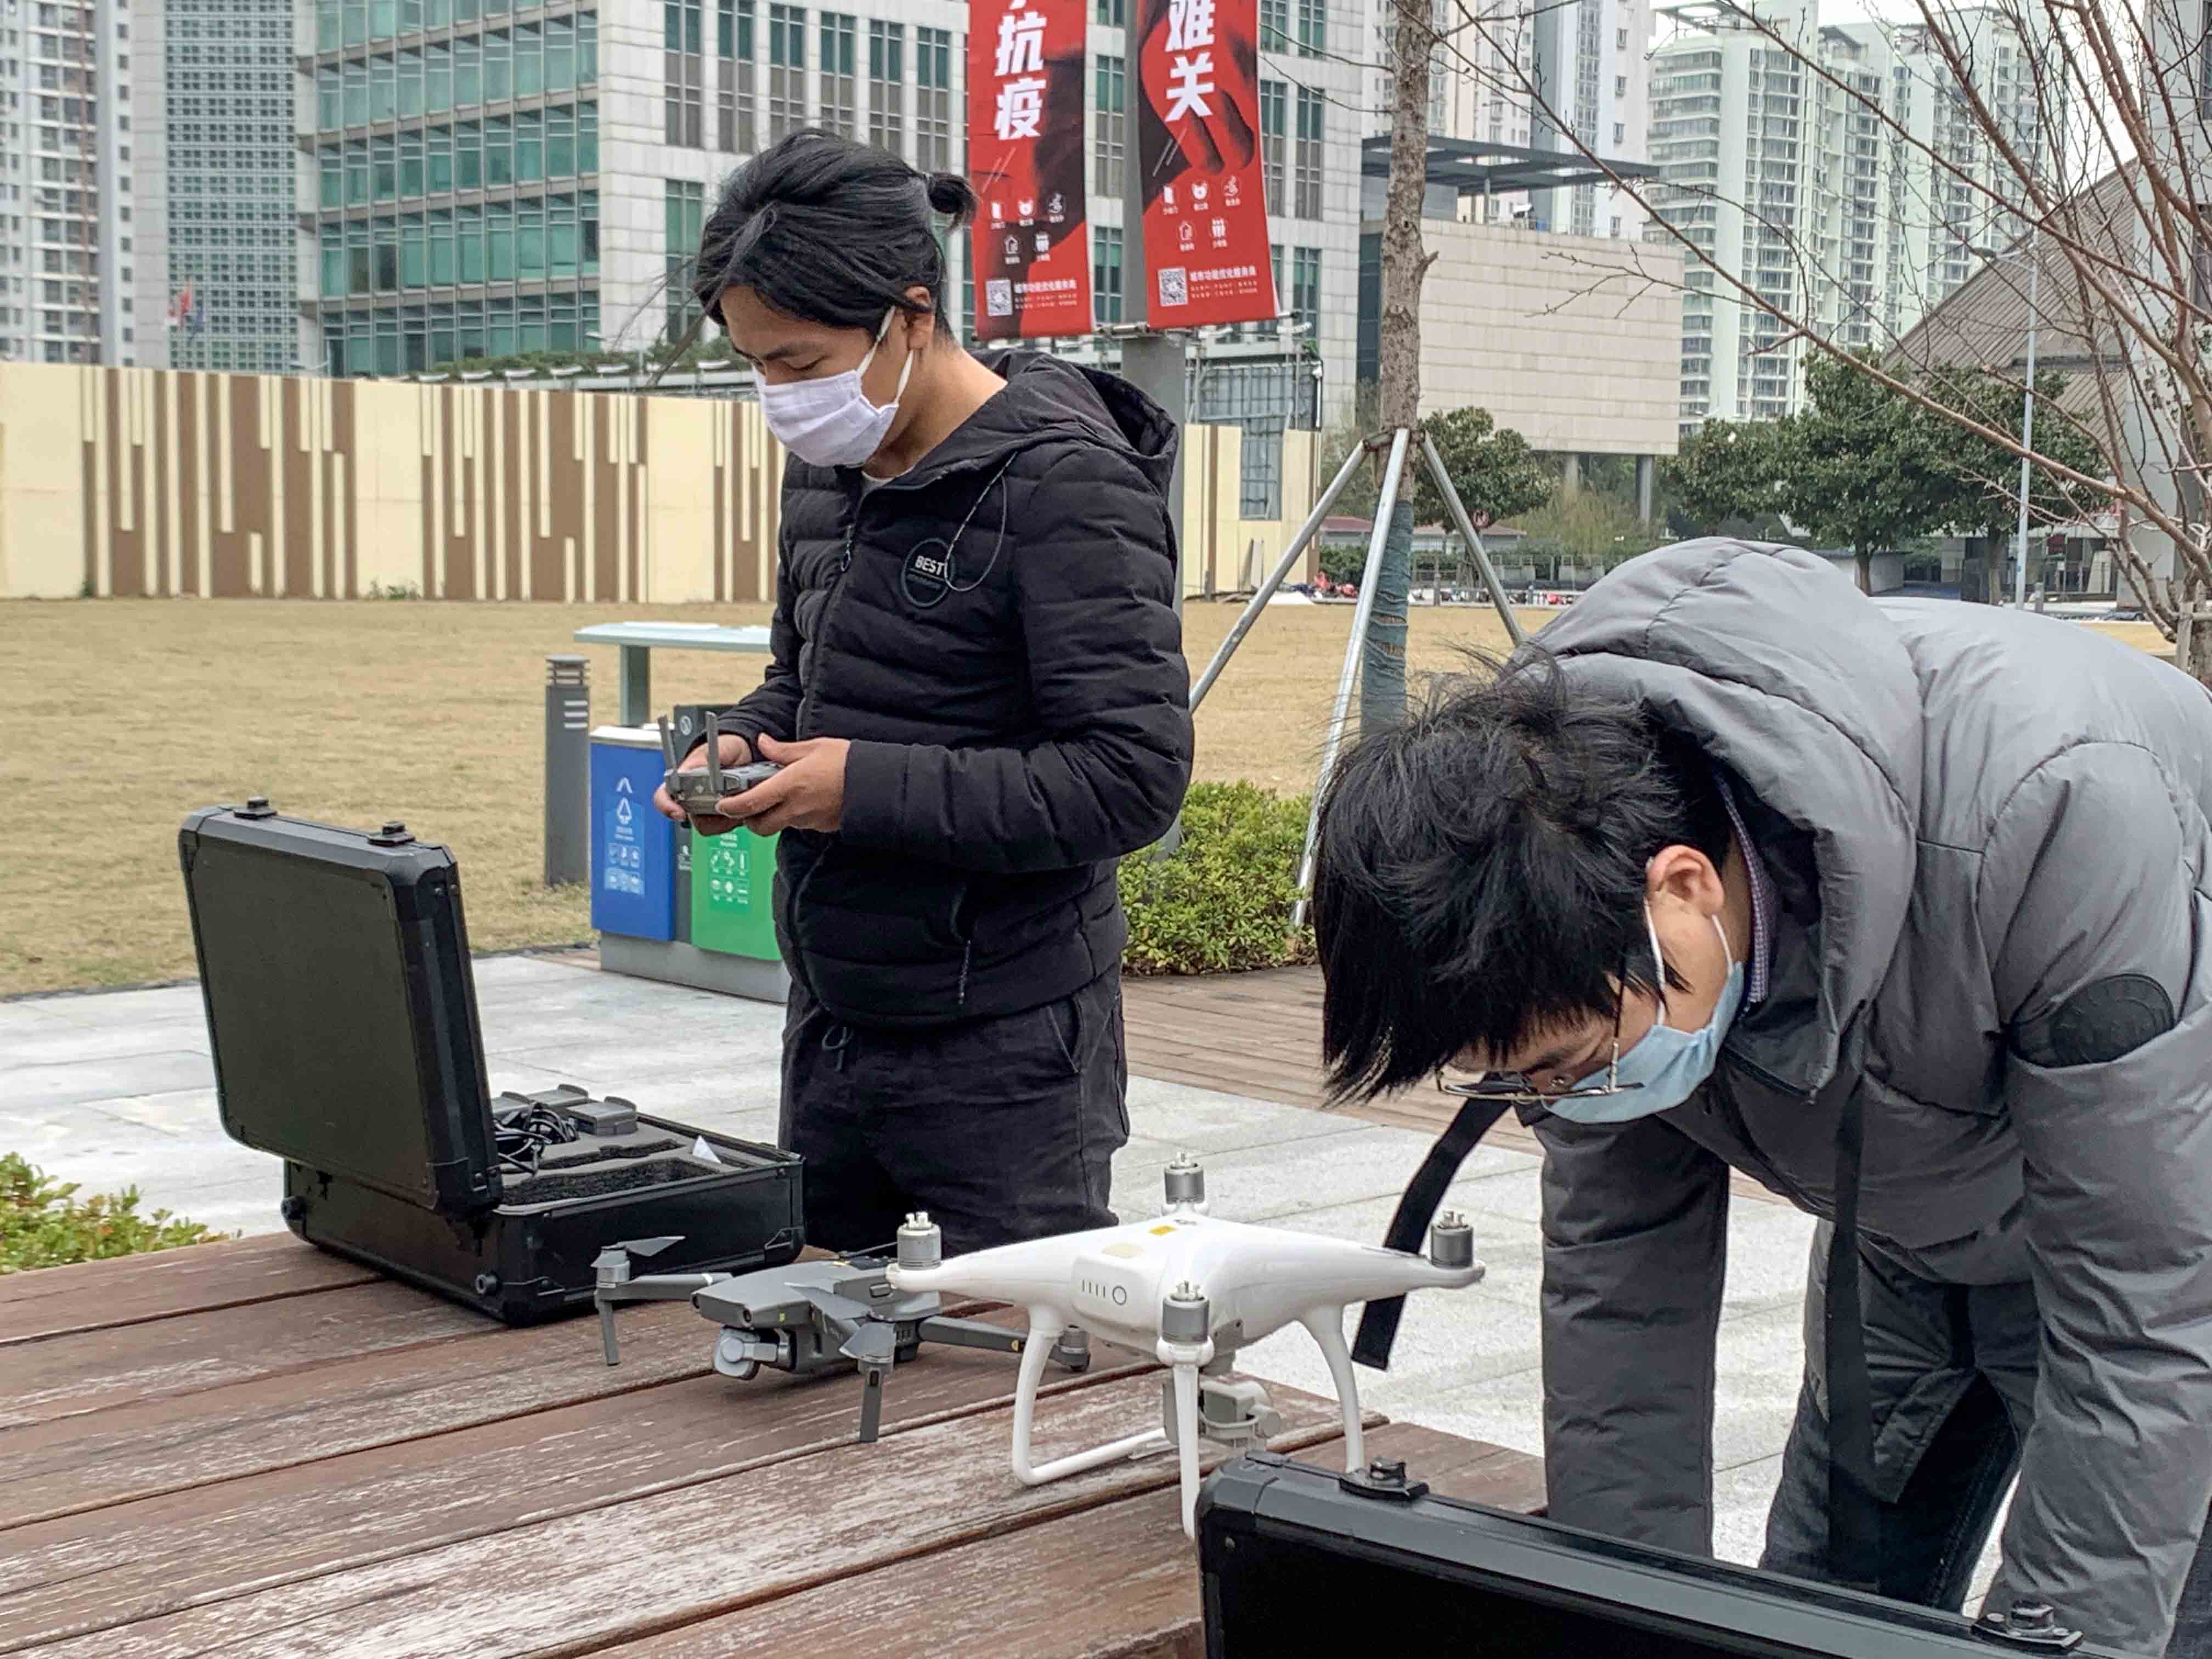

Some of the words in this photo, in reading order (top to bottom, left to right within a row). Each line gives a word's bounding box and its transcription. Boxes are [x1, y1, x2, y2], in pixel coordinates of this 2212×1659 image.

[994, 0, 1047, 140] 抗疫
[1165, 0, 1215, 122] 难关
[915, 555, 944, 575] BEST
